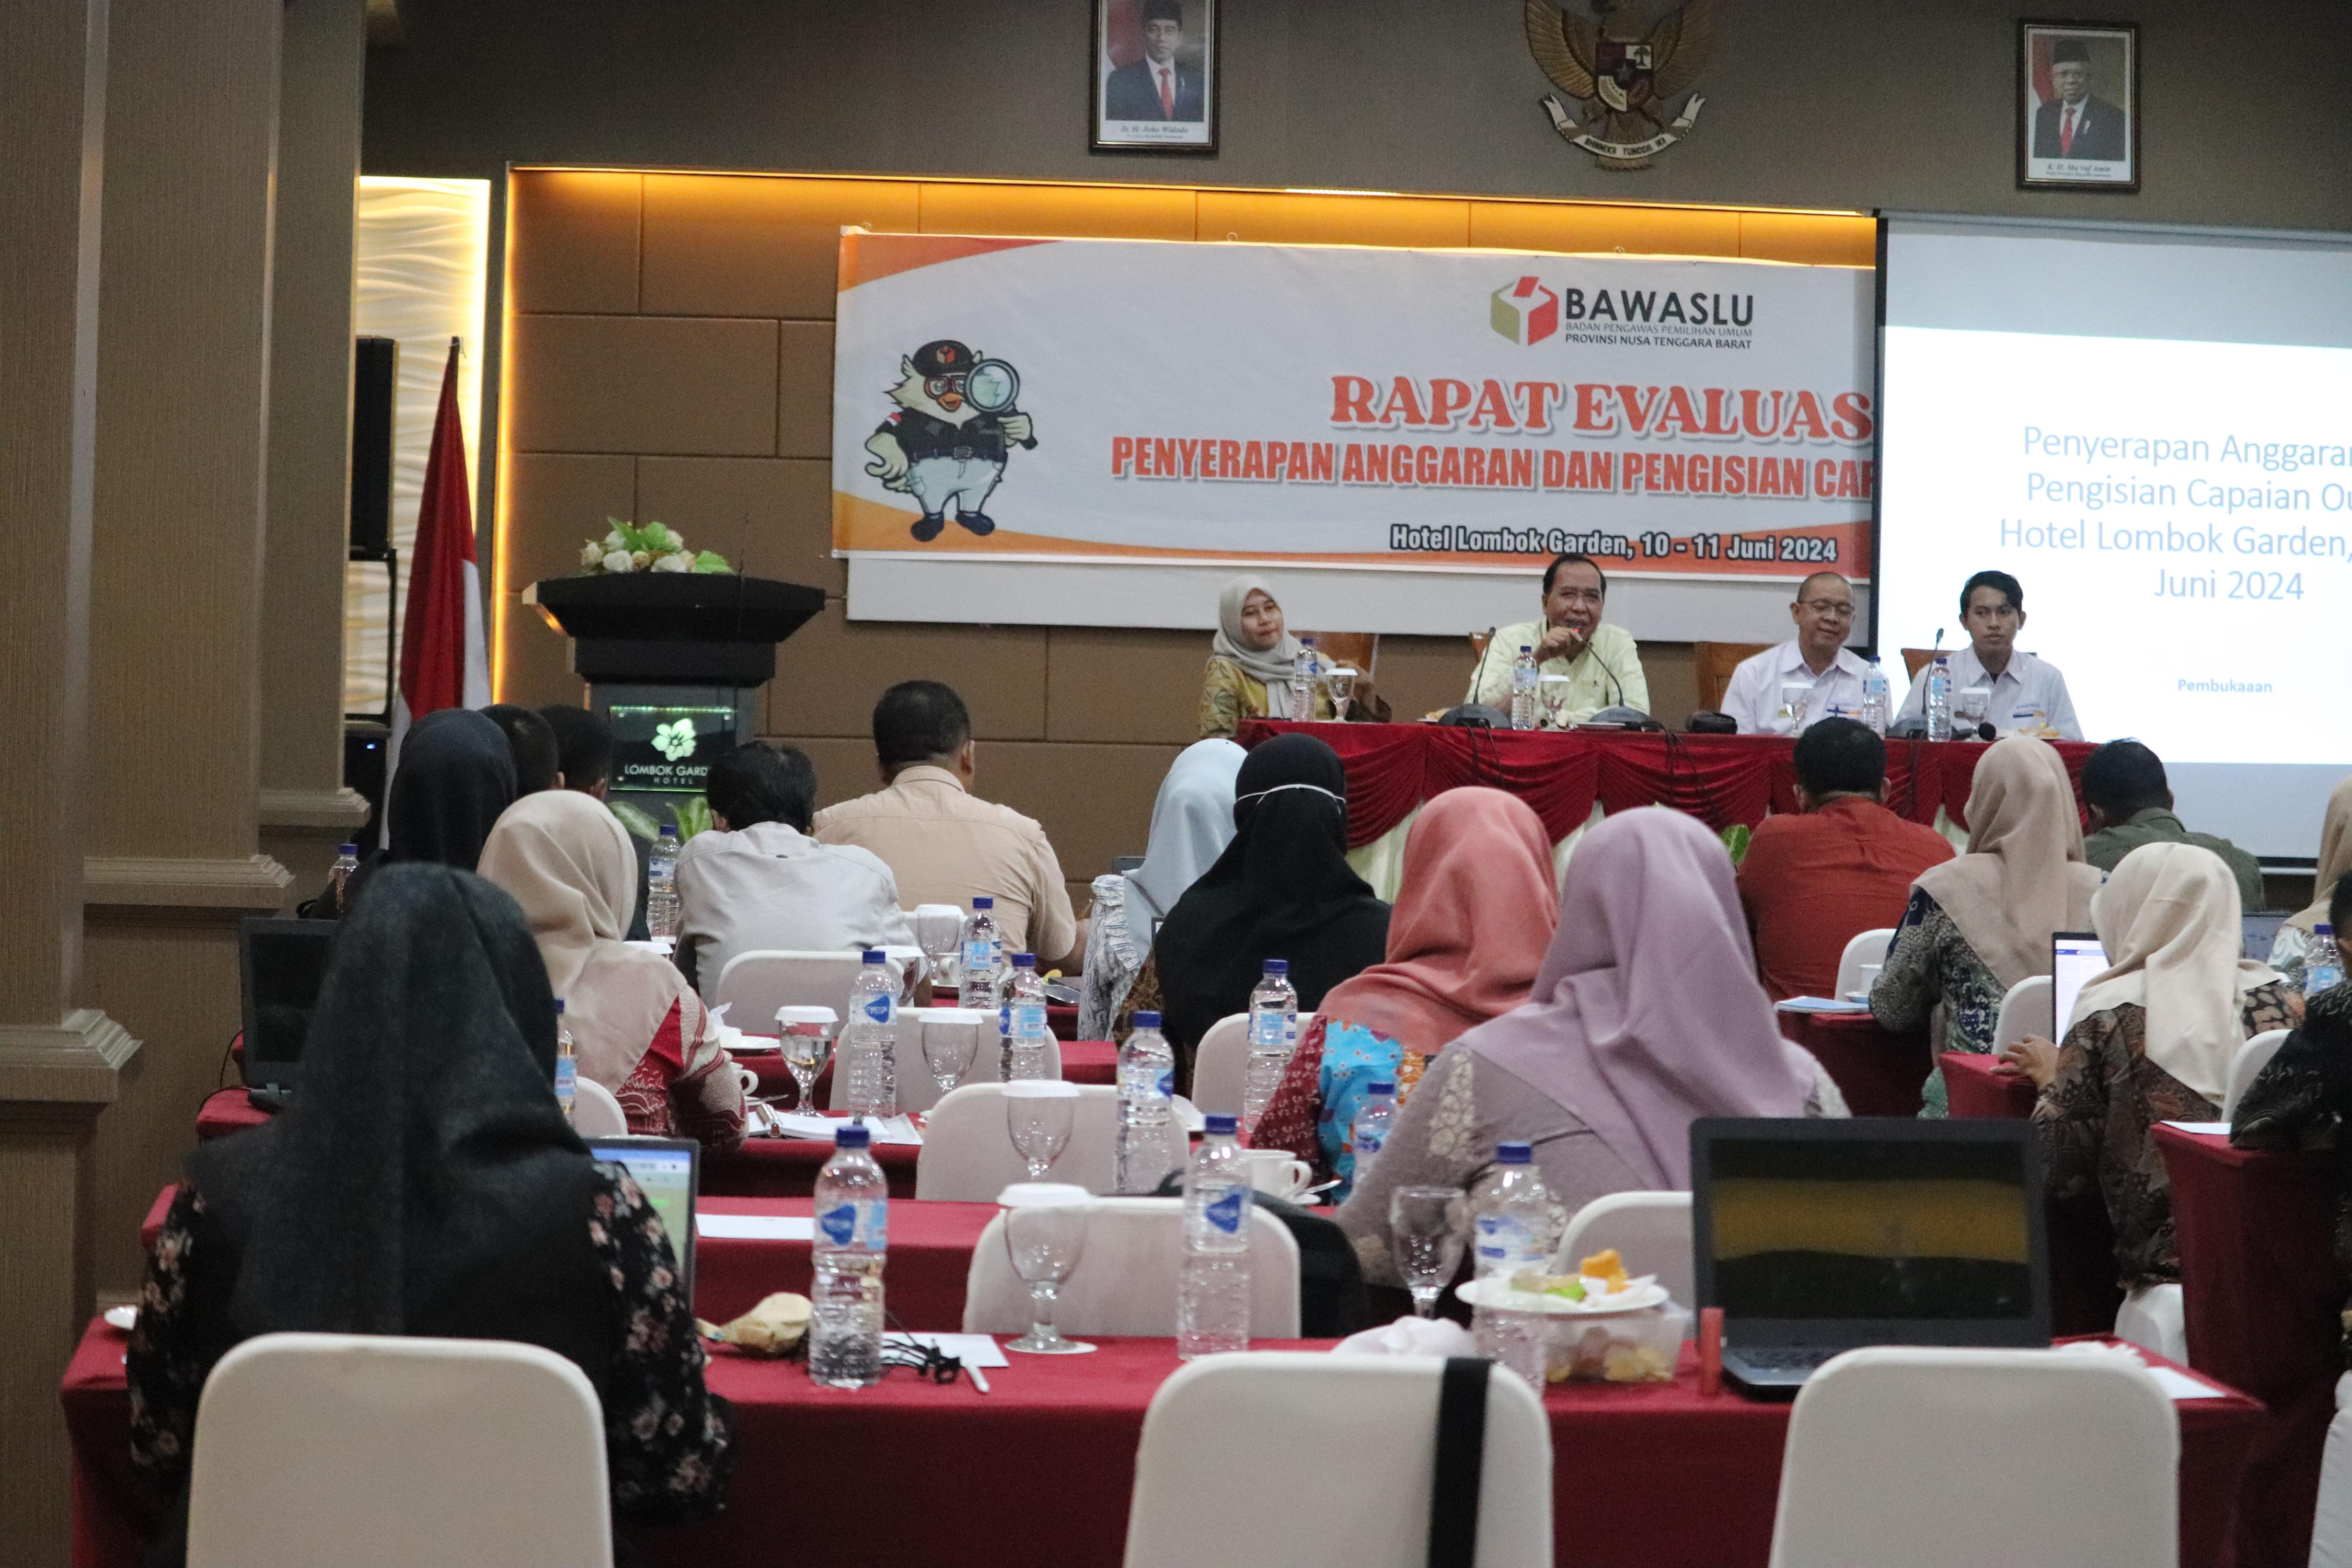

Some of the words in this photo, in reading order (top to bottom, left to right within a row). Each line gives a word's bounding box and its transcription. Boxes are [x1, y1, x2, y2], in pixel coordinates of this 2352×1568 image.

[1565, 287, 1753, 327] BAWASLU
[1565, 322, 1600, 332] BADAN
[1604, 324, 1659, 335] PENGAWAS
[1662, 326, 1717, 336] PEMILIHAN
[1719, 327, 1753, 337] UMUM
[1565, 333, 1617, 344] PROVINSI
[1620, 336, 1650, 345] NUSA
[1653, 337, 1713, 348] TENGGARA
[1716, 340, 1752, 350] BARAT
[1331, 375, 1559, 429] RAPAT
[1111, 436, 1334, 481] PENYERAPAN
[1342, 443, 1533, 487] ANGGARAN
[1542, 449, 1612, 490] DAN
[1622, 452, 1805, 497] PENGISIAN
[2024, 426, 2209, 467] Penyerapan
[2220, 434, 2352, 472] Anggara
[2028, 472, 2176, 511] Pengisian
[2187, 478, 2310, 515] Capaian
[1391, 524, 1451, 549] Hotel
[1456, 526, 1543, 553] Lombok
[1548, 528, 1634, 560] Garden,
[1640, 532, 1670, 557] 10
[1675, 543, 1687, 553] -
[1692, 533, 1720, 559] 11
[1726, 535, 1776, 560] Juni
[1779, 536, 1838, 563] 2024
[2000, 518, 2085, 549] Hotel
[2098, 522, 2224, 554] Lombok
[2233, 525, 2352, 563] Garden,
[2154, 569, 2216, 598] Juni
[2228, 570, 2305, 600] 2024
[2177, 678, 2273, 693] Pembukaaan
[625, 765, 673, 776] LOMBOK
[676, 766, 711, 777] GARD
